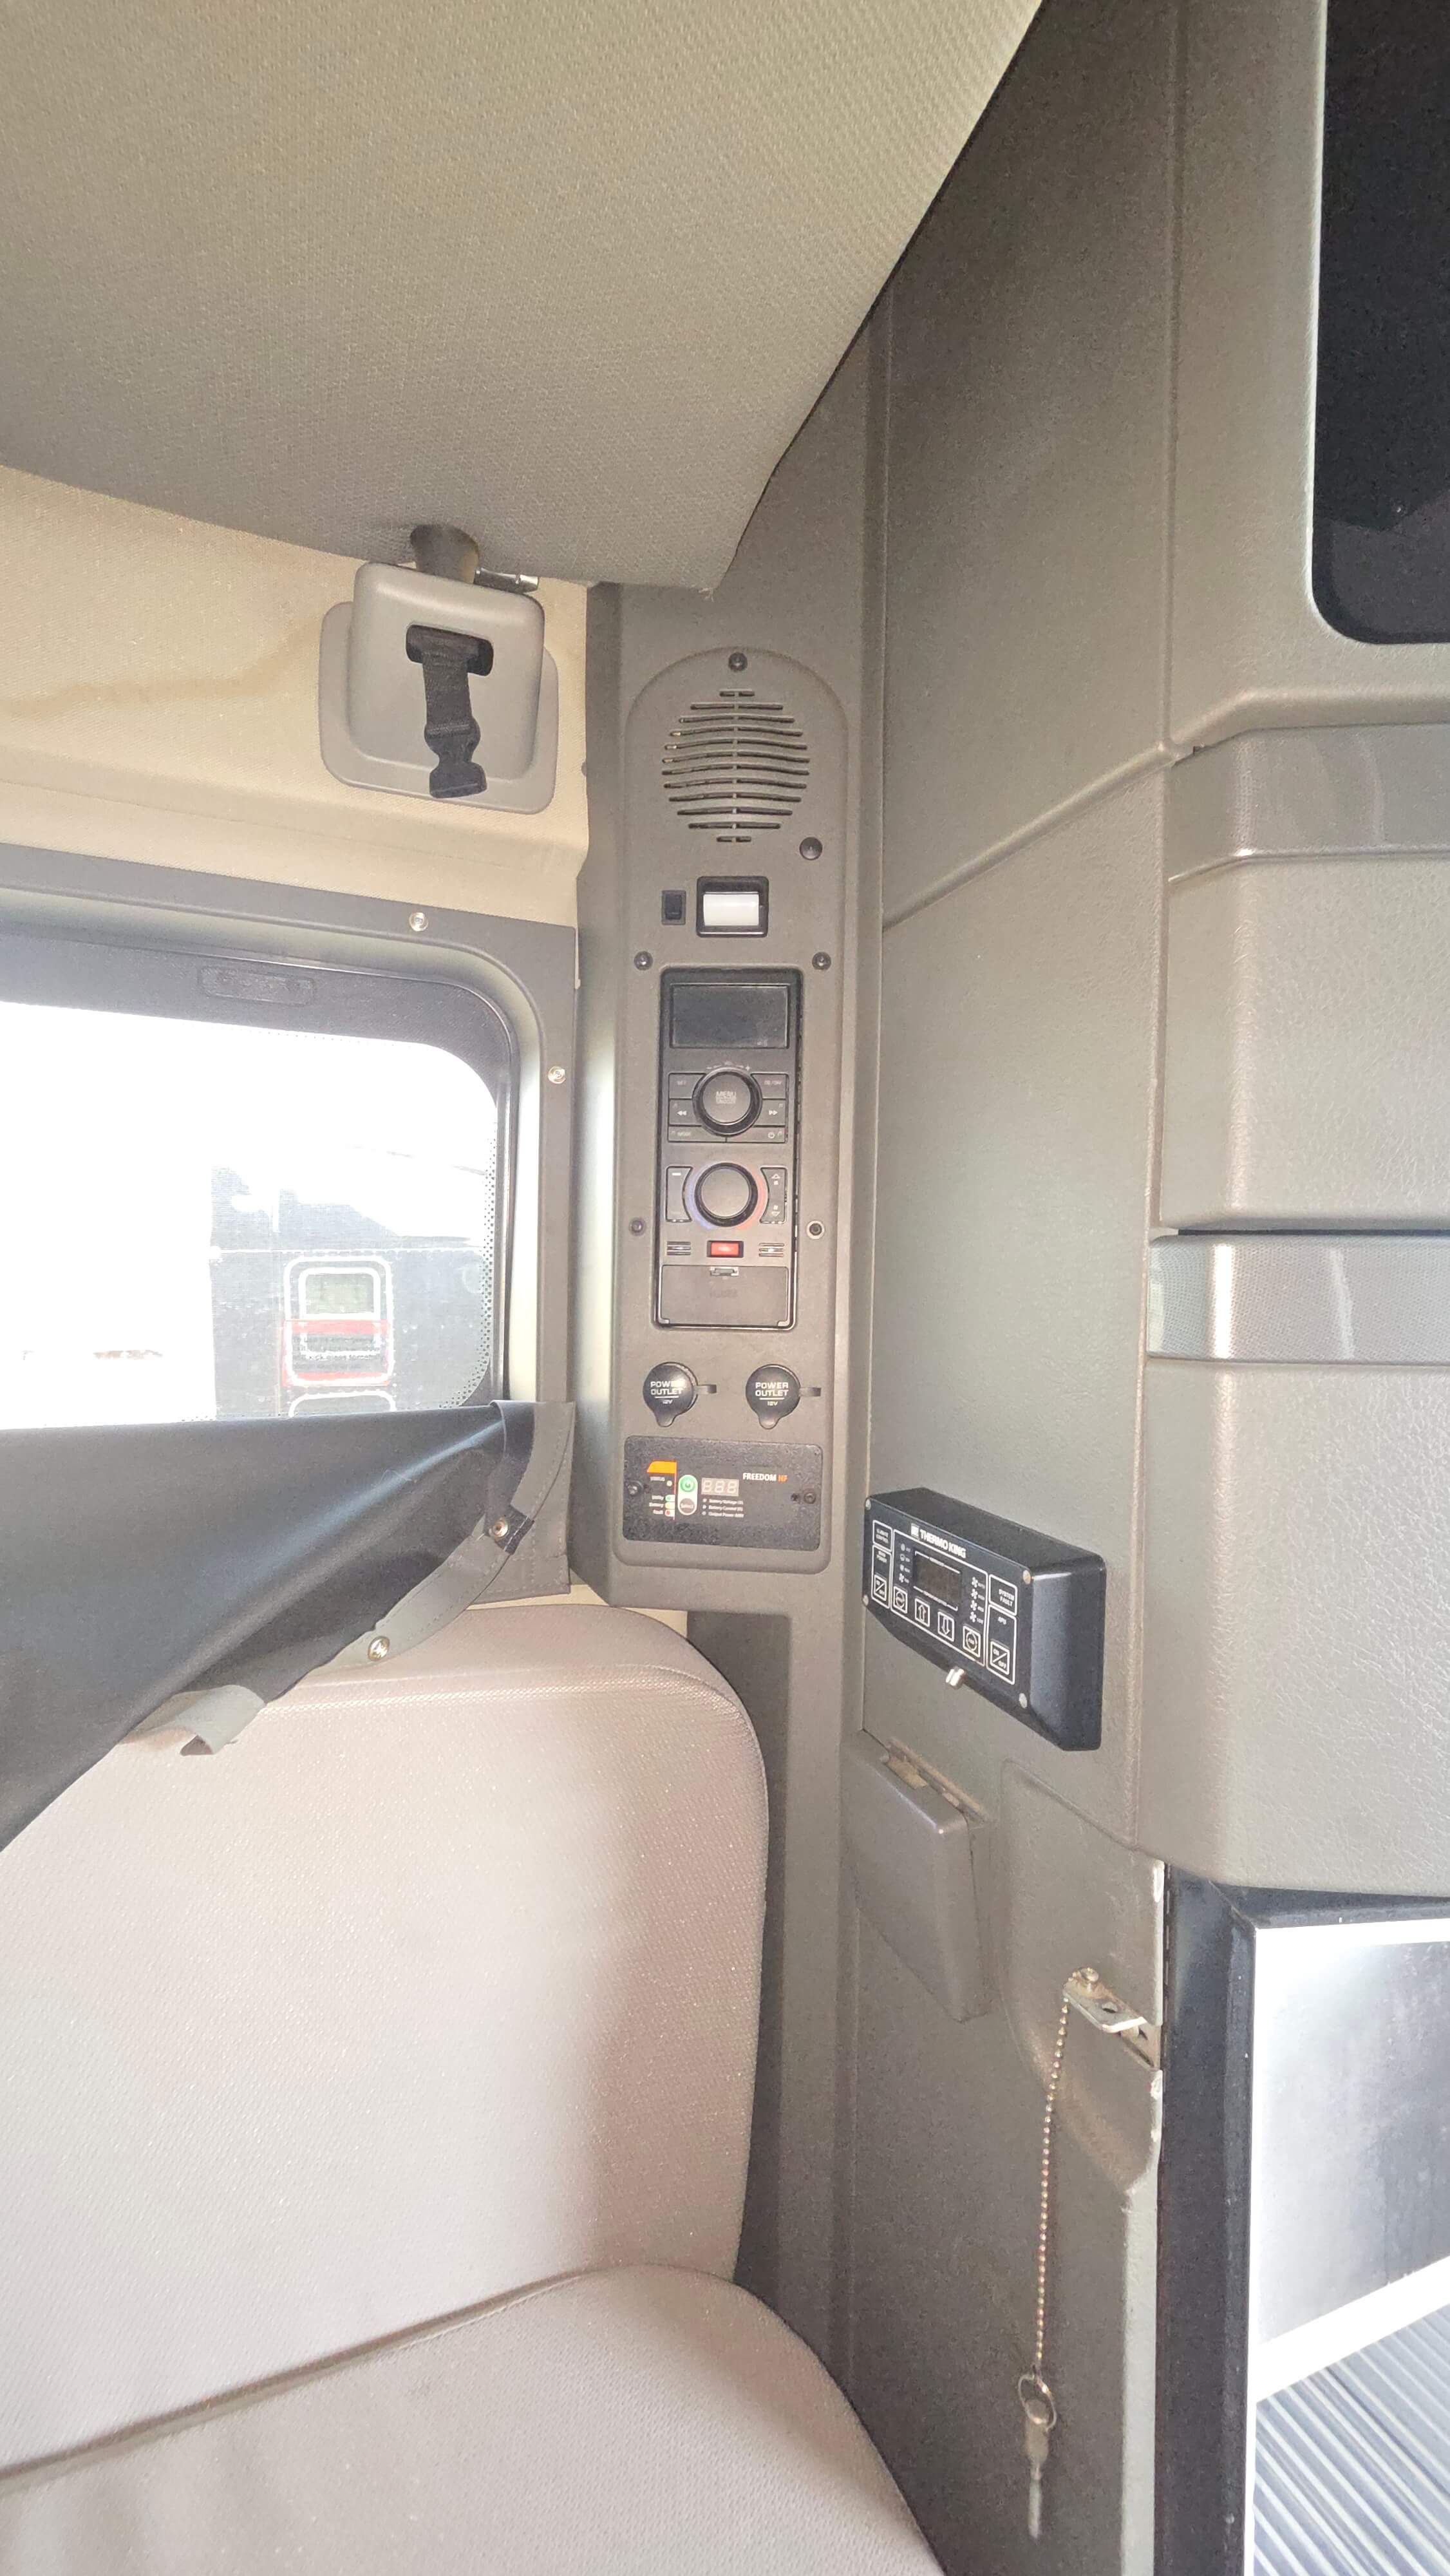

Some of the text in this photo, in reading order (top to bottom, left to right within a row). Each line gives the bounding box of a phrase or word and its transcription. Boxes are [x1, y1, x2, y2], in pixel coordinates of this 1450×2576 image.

[742, 1472, 777, 1481] FREEDOM
[919, 1528, 966, 1559] THERMO KING
[999, 1588, 1015, 1601] SYSTEM
[999, 1595, 1013, 1607] FAULT
[992, 1648, 1000, 1656] ON
[997, 1660, 1007, 1669] OFF
